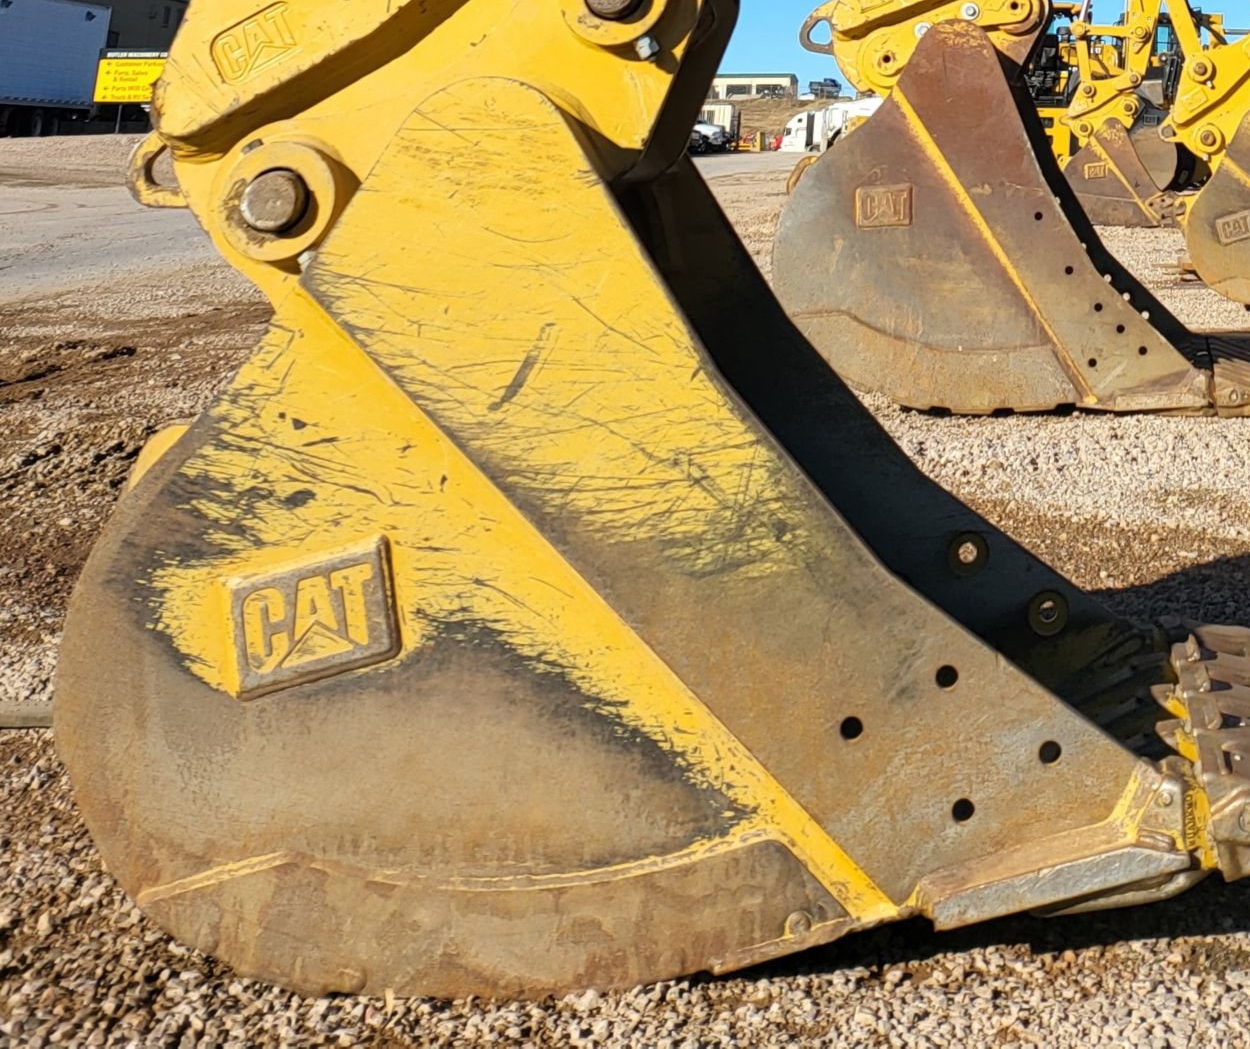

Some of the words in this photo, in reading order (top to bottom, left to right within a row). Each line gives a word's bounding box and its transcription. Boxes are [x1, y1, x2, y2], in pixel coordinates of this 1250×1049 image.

[213, 3, 298, 81] CAT
[861, 191, 908, 222] CAT
[1221, 215, 1249, 241] CAT
[242, 561, 373, 675] CAT
